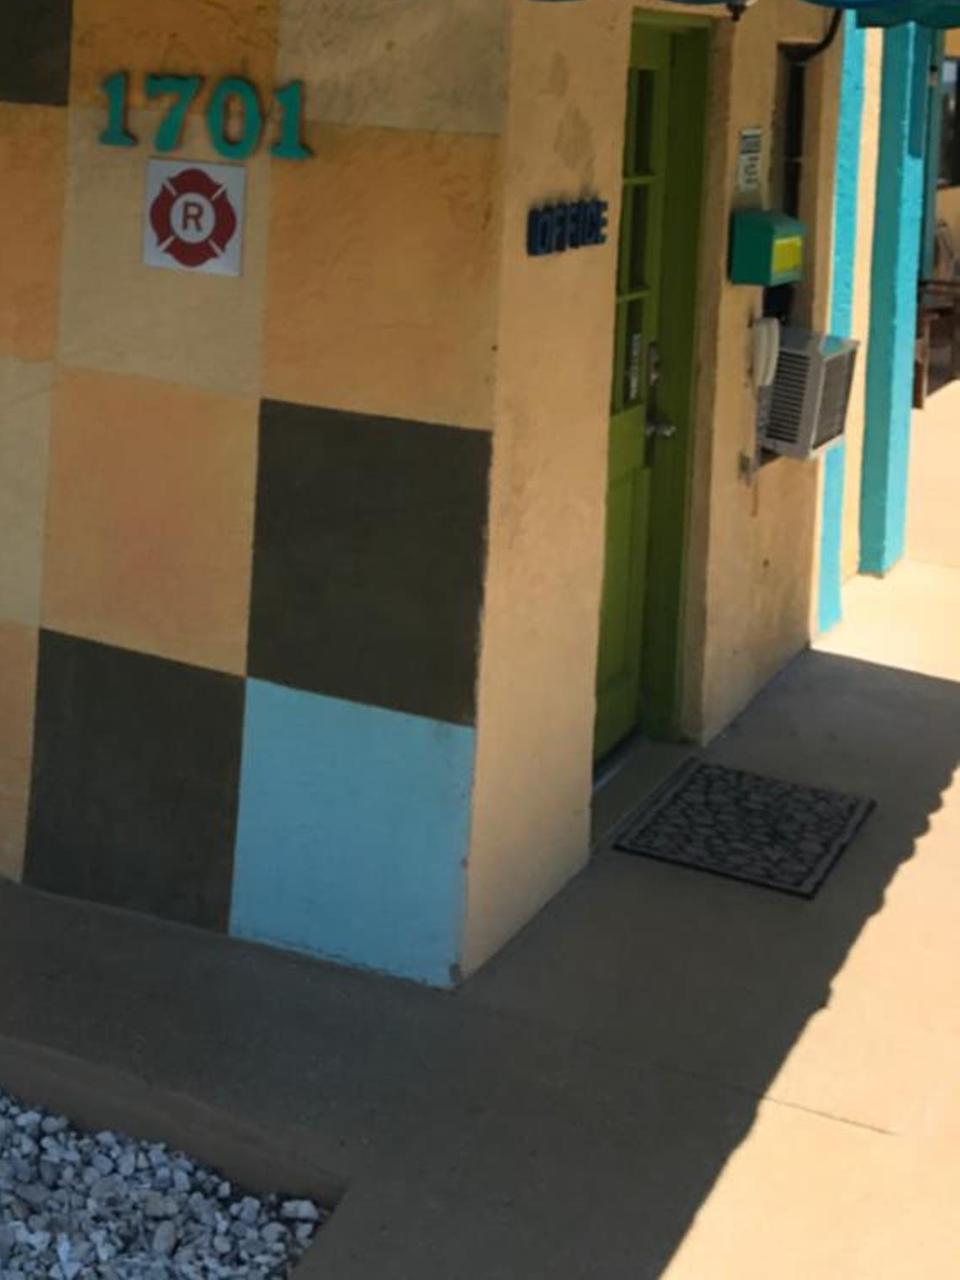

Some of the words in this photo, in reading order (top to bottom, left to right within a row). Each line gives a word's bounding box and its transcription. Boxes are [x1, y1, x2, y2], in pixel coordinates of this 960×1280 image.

[98, 70, 315, 161] 1701
[180, 200, 204, 232] R
[526, 199, 608, 256] OFFICE
